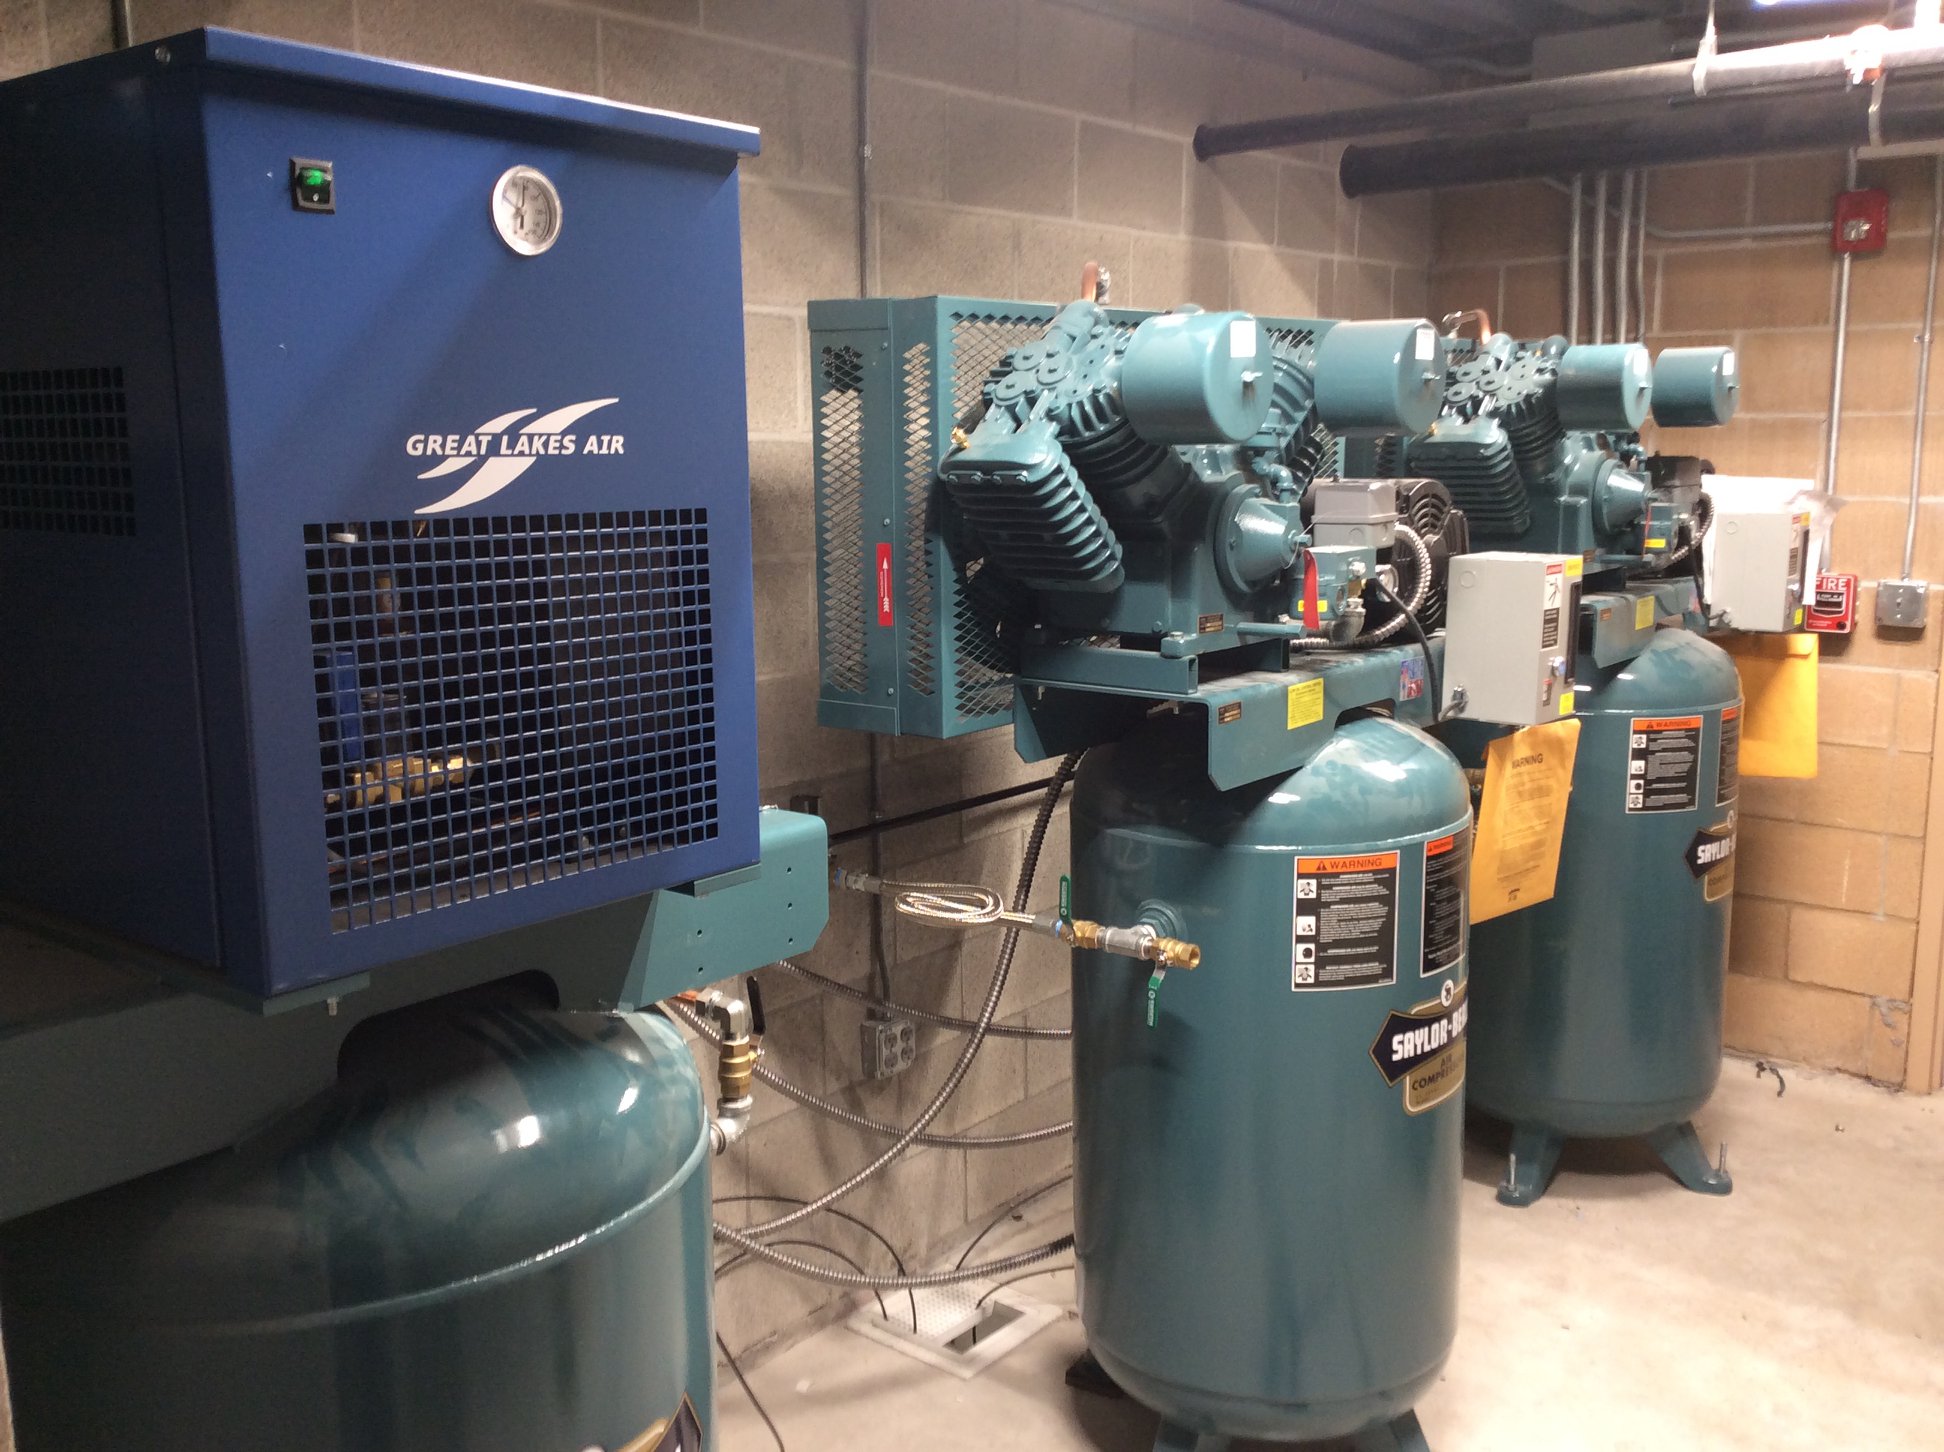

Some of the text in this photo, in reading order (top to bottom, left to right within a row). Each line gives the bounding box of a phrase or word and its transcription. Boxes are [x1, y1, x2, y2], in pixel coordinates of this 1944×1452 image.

[406, 434, 625, 456] GREAT LAKES AIR
[1815, 577, 1848, 591] FIRE
[1656, 720, 1692, 728] WARNING
[1511, 753, 1544, 769] WARNING
[1329, 857, 1383, 870] WARNING
